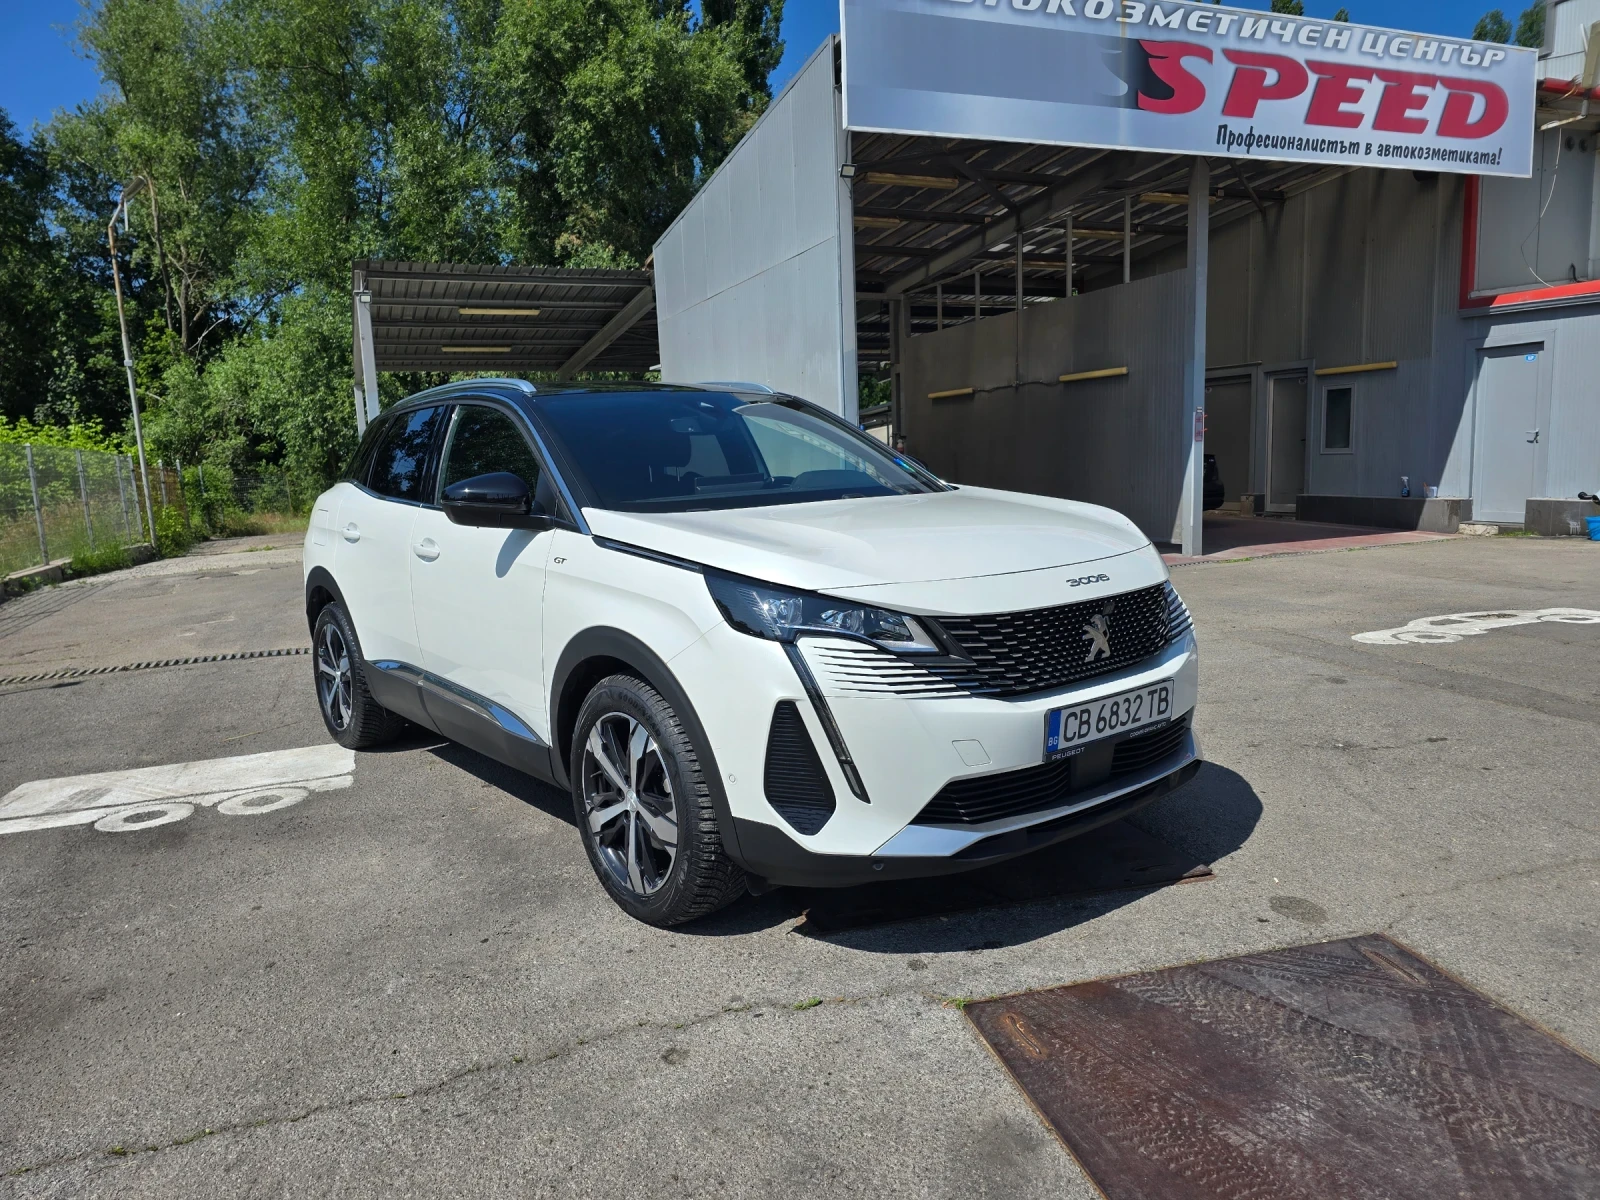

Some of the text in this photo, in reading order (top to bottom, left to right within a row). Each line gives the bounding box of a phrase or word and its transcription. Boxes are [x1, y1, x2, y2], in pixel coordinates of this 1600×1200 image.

[948, 0, 1506, 67] ОКОЗМЕТИЧЕН ЦЕНТЪР
[1137, 38, 1510, 140] SPEED
[1216, 124, 1503, 166] Професионалистът в автокозметиката!
[553, 556, 568, 565] GT
[1065, 573, 1110, 587] 3008
[1063, 686, 1169, 742] CB 6832 TB
[1047, 735, 1058, 747] BG
[1051, 747, 1086, 761] PEUGEOT
